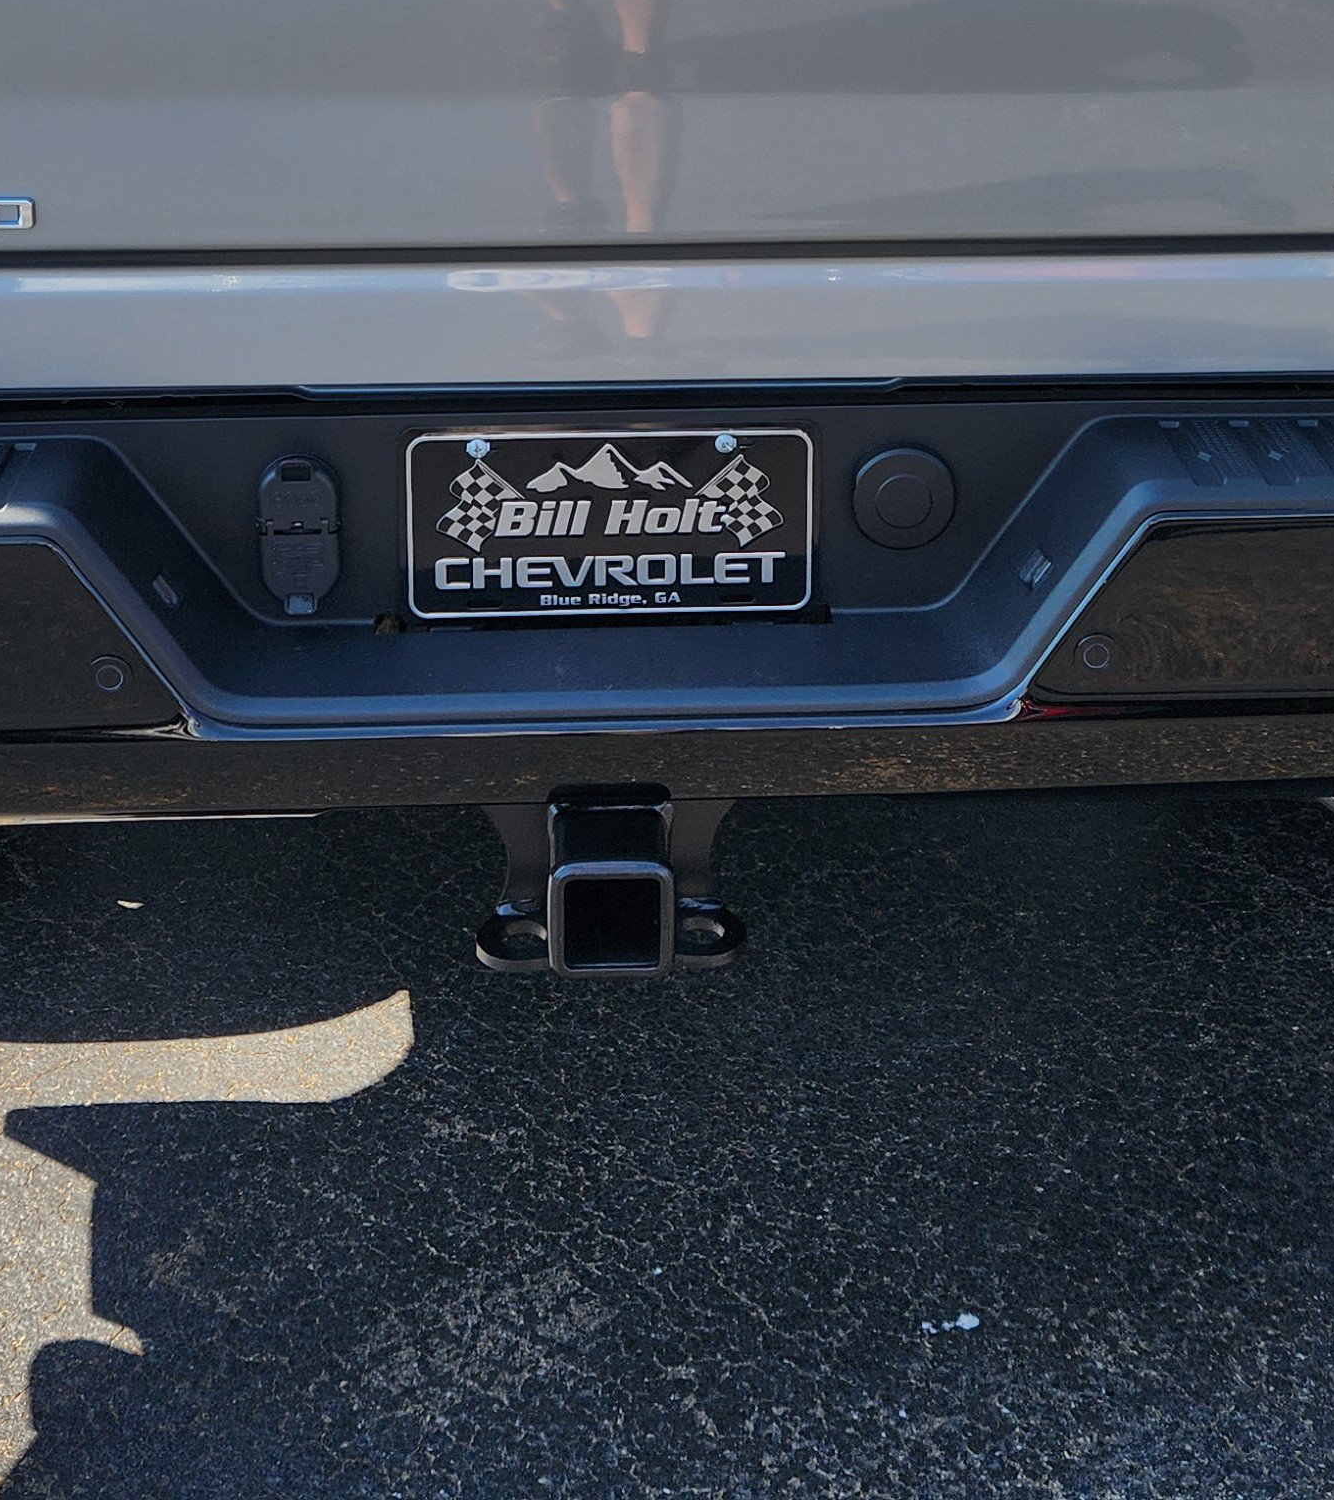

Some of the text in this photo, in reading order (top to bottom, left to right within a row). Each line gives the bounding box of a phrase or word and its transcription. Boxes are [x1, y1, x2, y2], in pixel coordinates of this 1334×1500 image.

[493, 498, 727, 538] Bill Holt
[434, 551, 786, 590] CHEVROLET
[539, 591, 681, 607] Blue Ridge, GA
